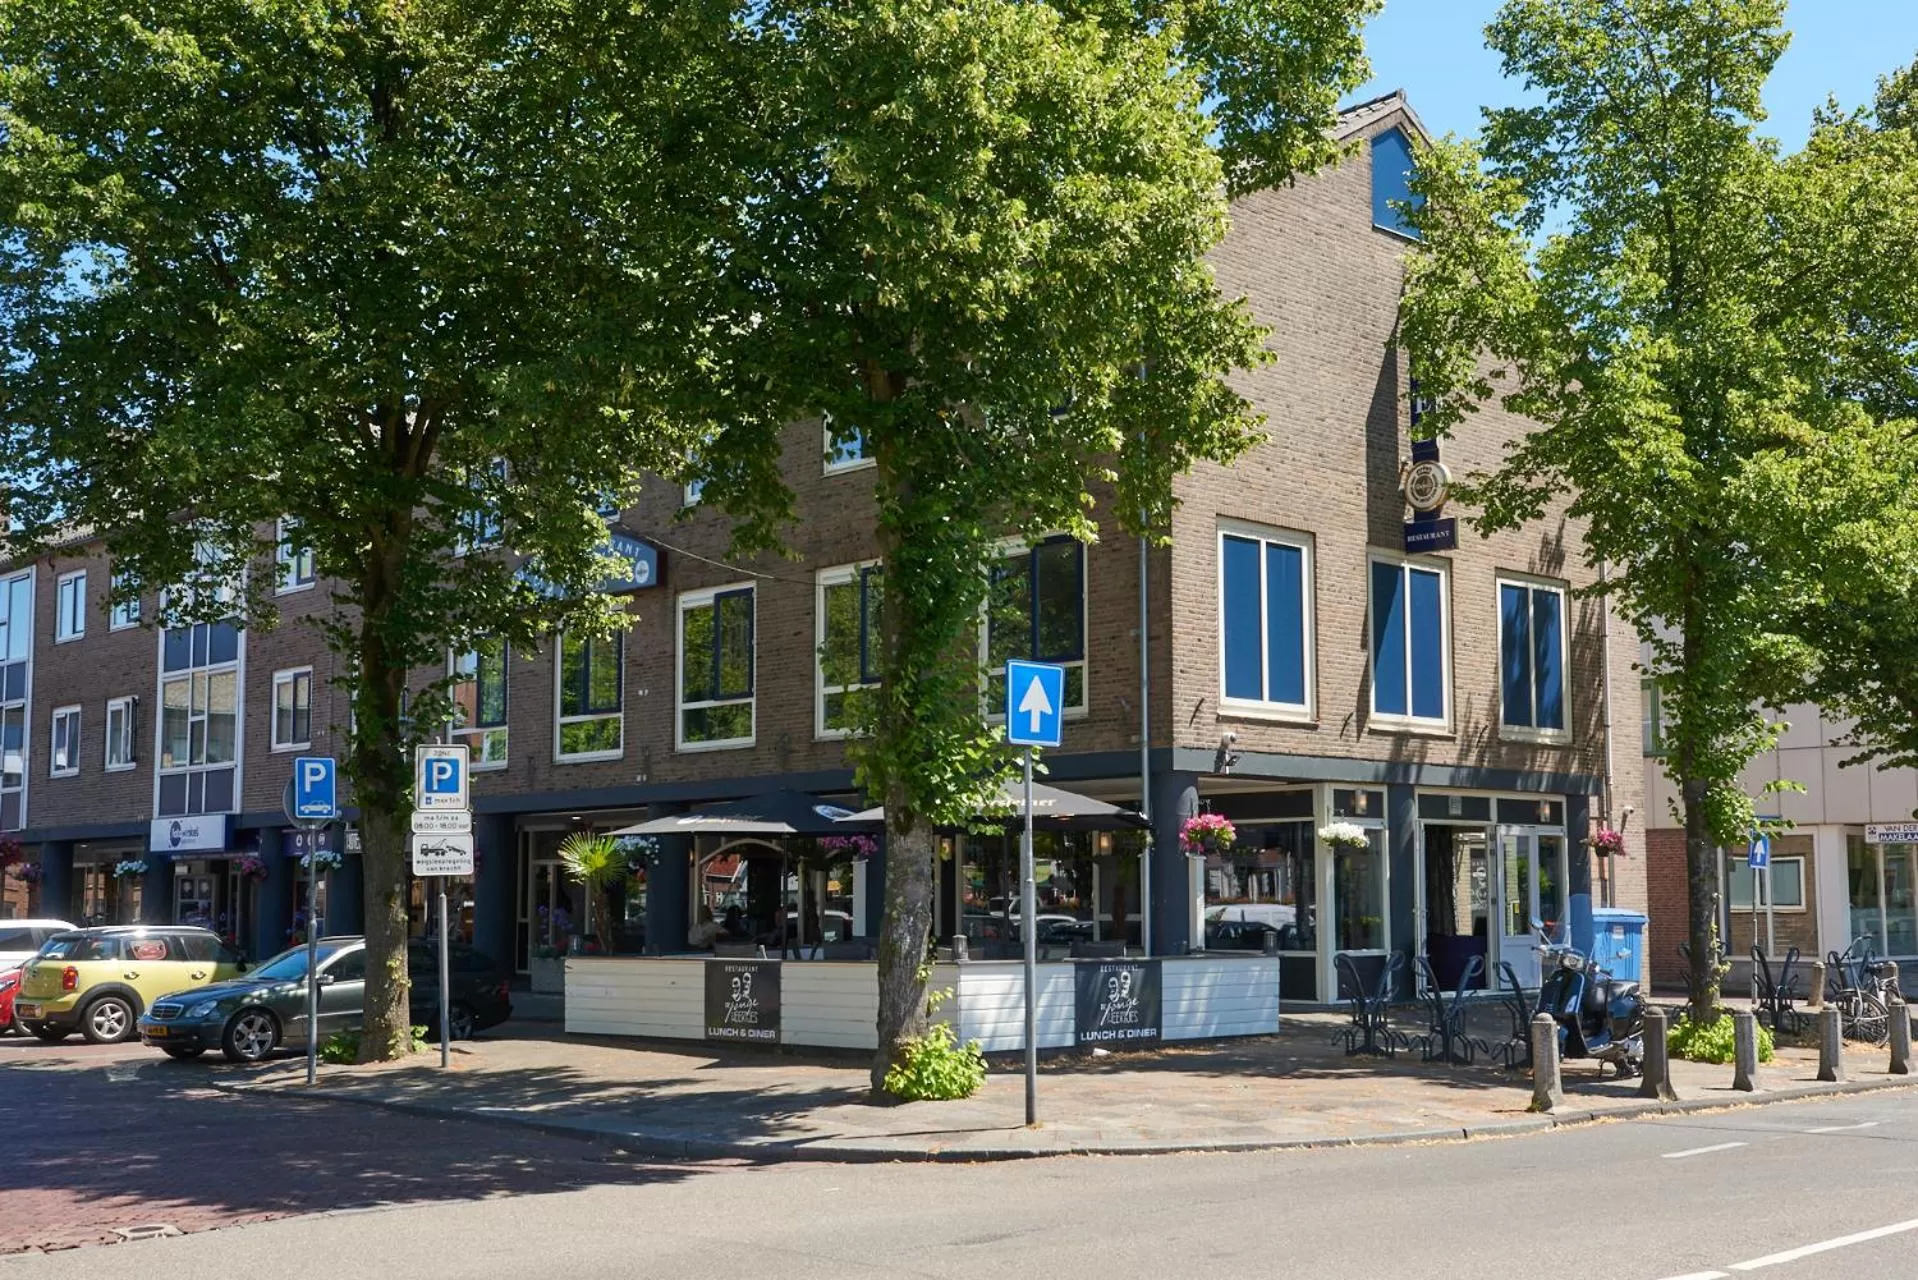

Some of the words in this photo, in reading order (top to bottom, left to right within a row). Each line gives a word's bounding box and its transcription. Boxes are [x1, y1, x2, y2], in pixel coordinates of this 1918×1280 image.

[1407, 531, 1450, 542] RESTAURANT
[304, 762, 327, 793] P
[432, 761, 452, 791] P
[1100, 964, 1138, 972] RESTAURANT
[708, 1027, 739, 1037] LUNCH
[740, 1028, 747, 1037] &
[748, 1029, 776, 1039] DINER
[1081, 1030, 1116, 1041] LUNCH
[1117, 1029, 1125, 1039] &
[1127, 1027, 1157, 1038] DINER
